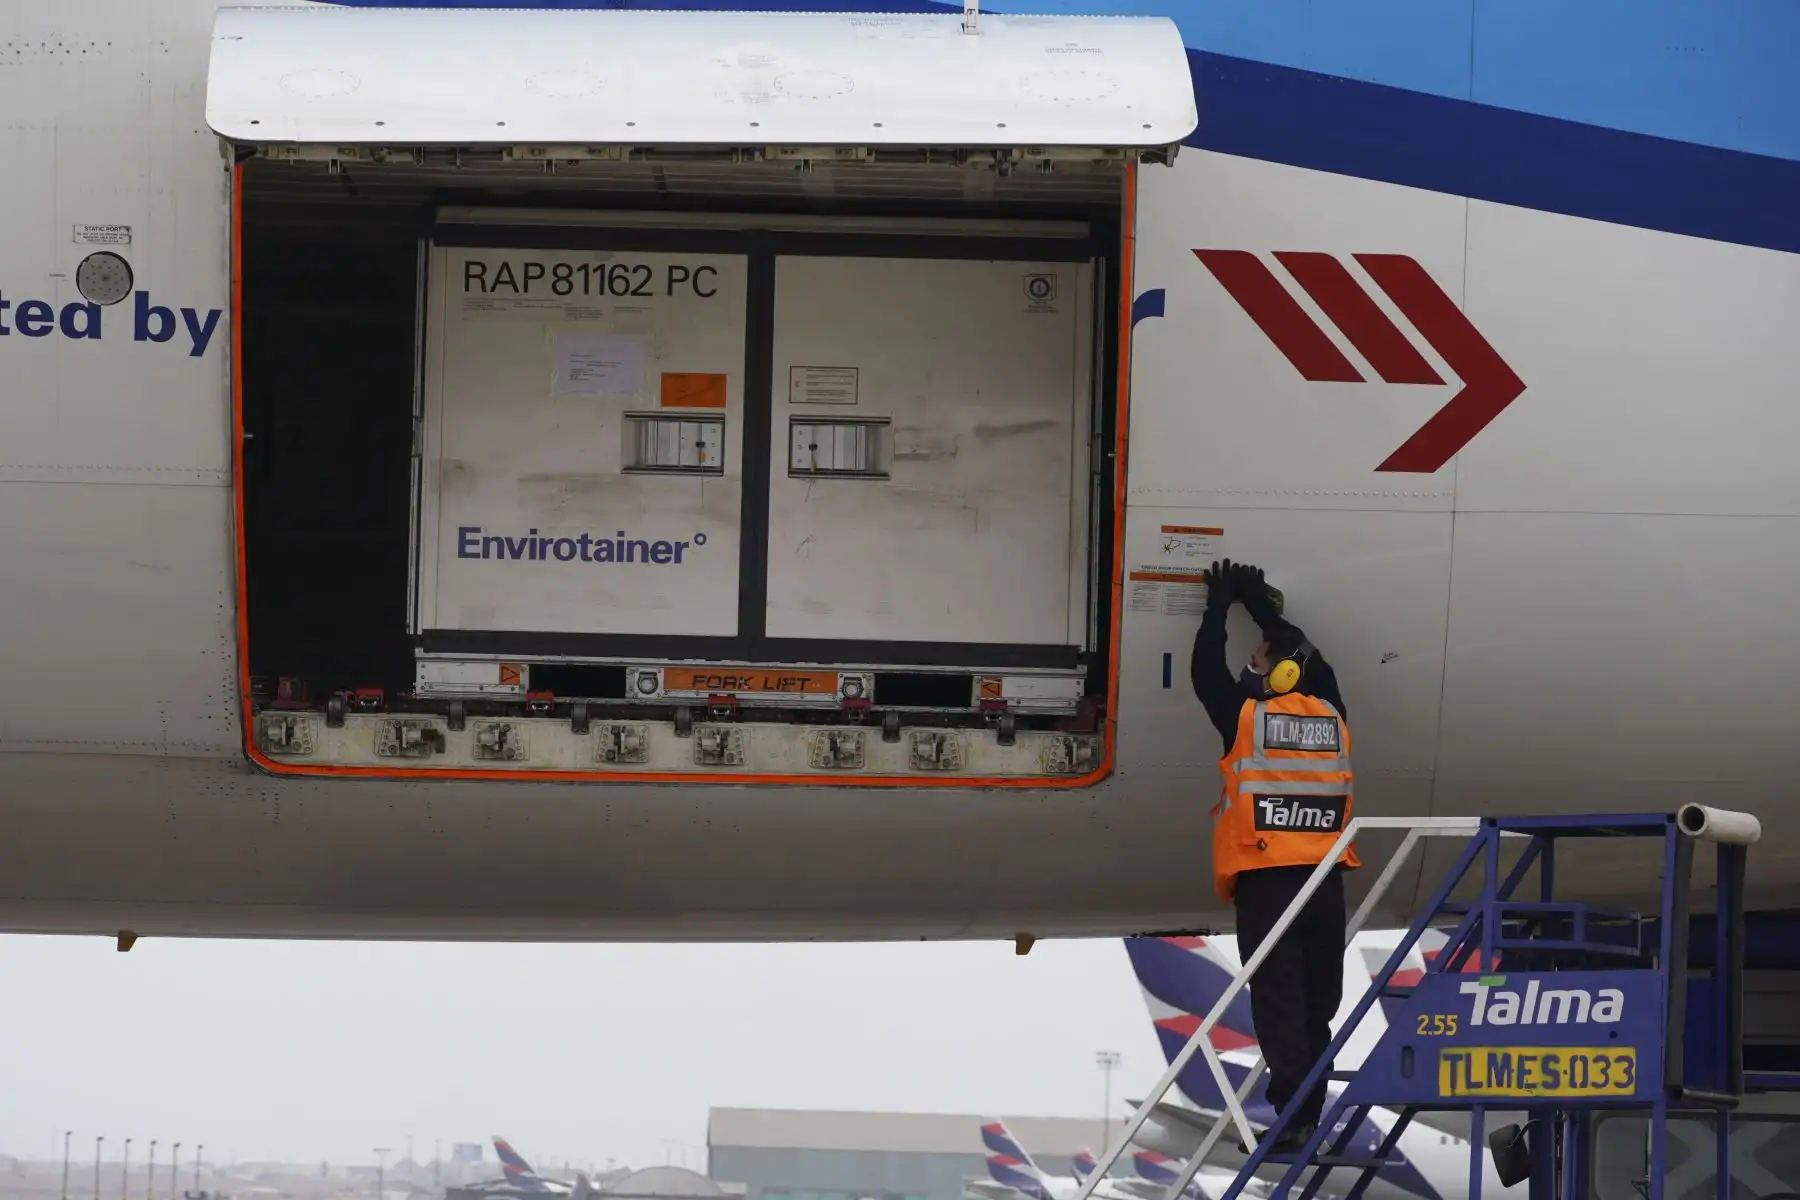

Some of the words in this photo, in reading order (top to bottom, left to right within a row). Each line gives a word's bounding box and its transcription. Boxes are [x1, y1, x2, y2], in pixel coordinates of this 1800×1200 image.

[666, 264, 718, 298] PC
[0, 290, 102, 340] ed
[134, 290, 223, 357] by
[692, 674, 755, 690] FORK
[763, 677, 811, 691] LIFT
[1258, 797, 1337, 829] Talma
[1459, 975, 1625, 1026] Talma
[1416, 1014, 1459, 1037] 2.55
